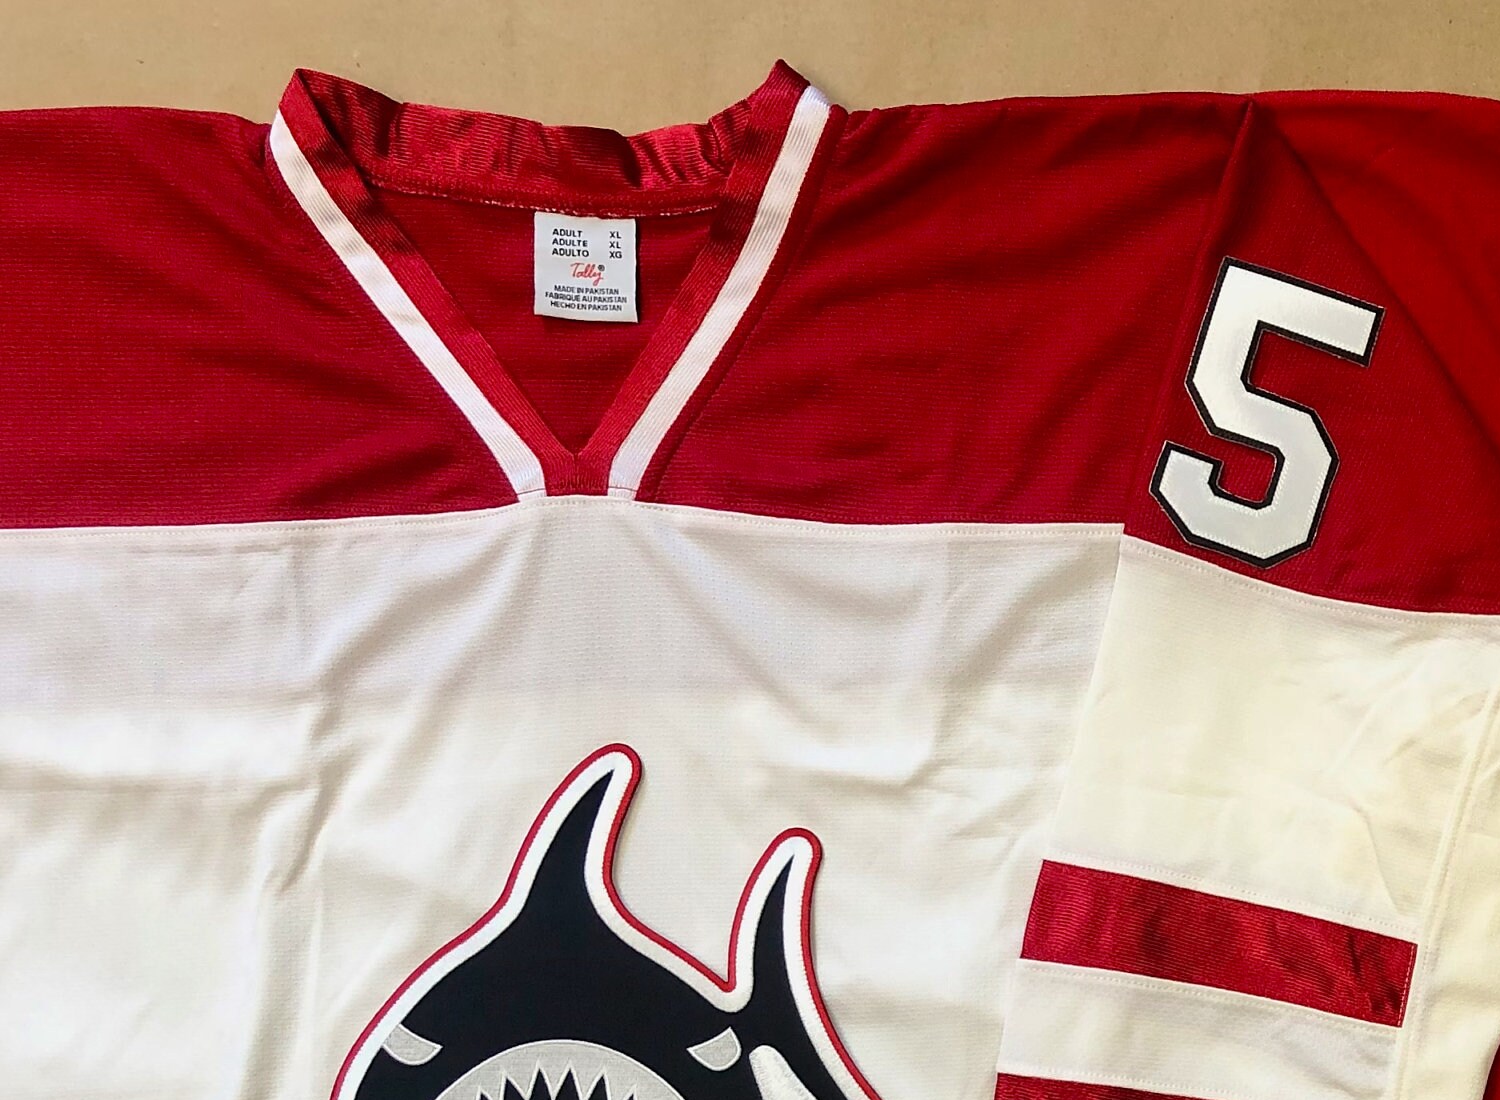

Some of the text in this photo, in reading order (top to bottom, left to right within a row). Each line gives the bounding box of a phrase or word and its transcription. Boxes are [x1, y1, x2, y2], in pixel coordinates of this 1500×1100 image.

[552, 228, 622, 239] ADULT XL
[551, 237, 622, 249] ADULTE XL
[551, 247, 623, 259] ADULTO XG
[554, 284, 576, 293] MADE
[585, 287, 619, 295] PAKISTAN
[581, 295, 593, 303] AU
[593, 296, 627, 304] PAKISTAN
[550, 300, 576, 309] HECHO
[588, 303, 622, 312] PAKISTAN
[1150, 256, 1386, 568] 5
